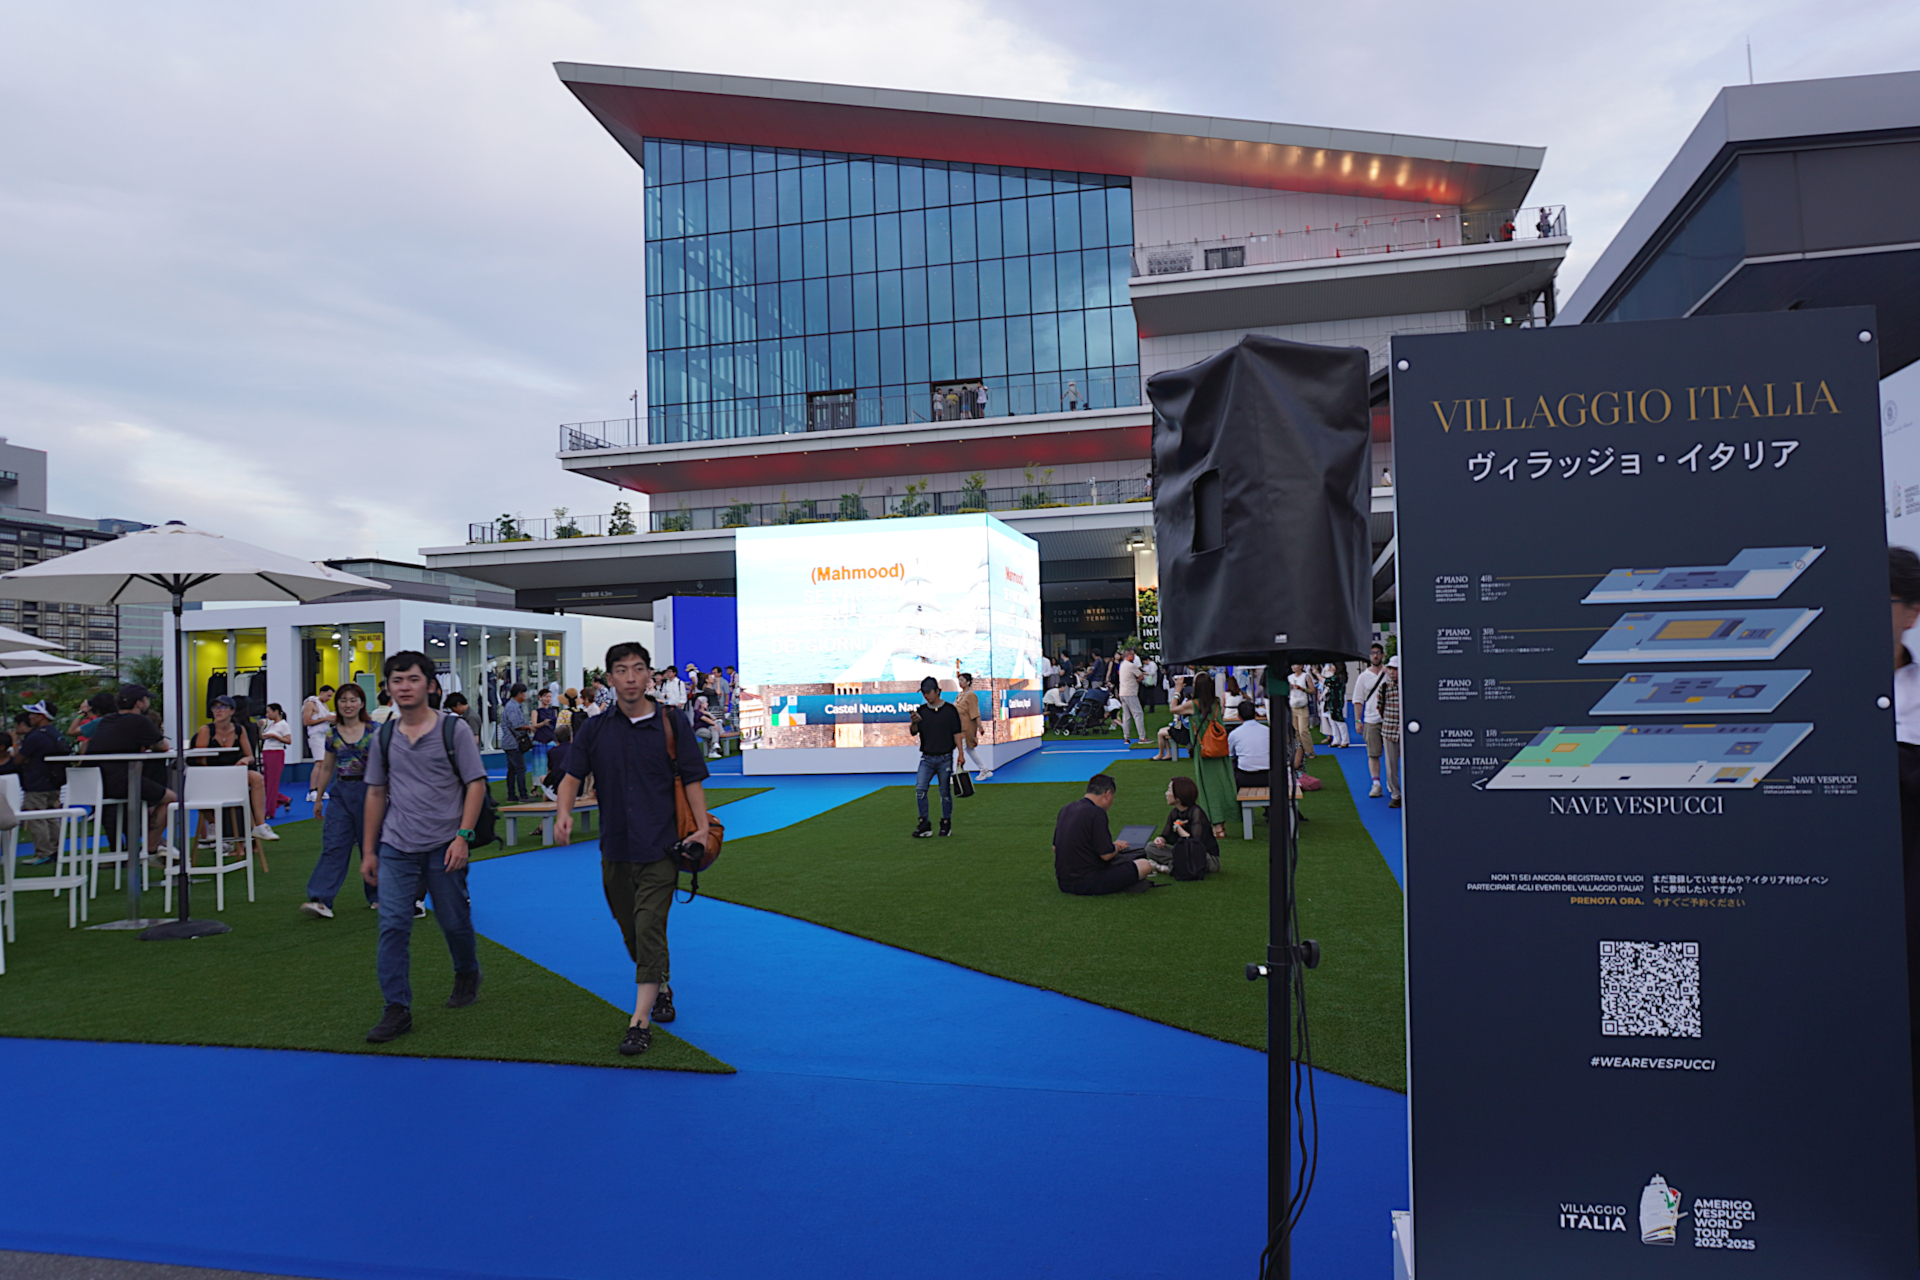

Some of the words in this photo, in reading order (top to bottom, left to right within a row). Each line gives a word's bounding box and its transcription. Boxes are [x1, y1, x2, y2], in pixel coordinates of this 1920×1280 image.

[1431, 388, 1672, 433] VILLAGGIO
[1687, 380, 1842, 422] ITALIA
[1467, 440, 1800, 482] ヴィラッジョ・イタリア
[811, 563, 905, 585] (Mahmood)
[1053, 616, 1080, 624] CRUISE
[1085, 614, 1124, 622] TERMINAL
[1445, 629, 1470, 637] PIANO
[1447, 679, 1471, 687] PIANO
[825, 704, 857, 715] Castel
[860, 703, 897, 715] Nuovo,
[1817, 775, 1857, 783] VESPUCCI
[1550, 796, 1608, 815] NAVE
[1613, 796, 1724, 815] VESPUCCI
[1532, 874, 1566, 882] ANCORA
[1567, 874, 1615, 882] REGISTRATO
[1535, 884, 1561, 892] EVENTI
[1562, 884, 1577, 892] DEL
[1577, 884, 1617, 892] VILLAGGIO
[1618, 884, 1644, 892] ITALIA?
[1570, 896, 1618, 905] PRENOTA
[1619, 897, 1645, 906] ORA.
[1652, 897, 1746, 907] 今すぐご予約ください
[1590, 1056, 1716, 1071] #WEAREVESPUCCI
[1560, 1203, 1627, 1216] VILLAGGIO
[1693, 1198, 1753, 1211] AMERIGO
[1693, 1208, 1755, 1221] VESPUCCI
[1560, 1214, 1627, 1231] ITALIA
[1694, 1217, 1743, 1230] WORLD
[1694, 1227, 1729, 1239] TOUR
[1694, 1237, 1756, 1250] 2023-2025
